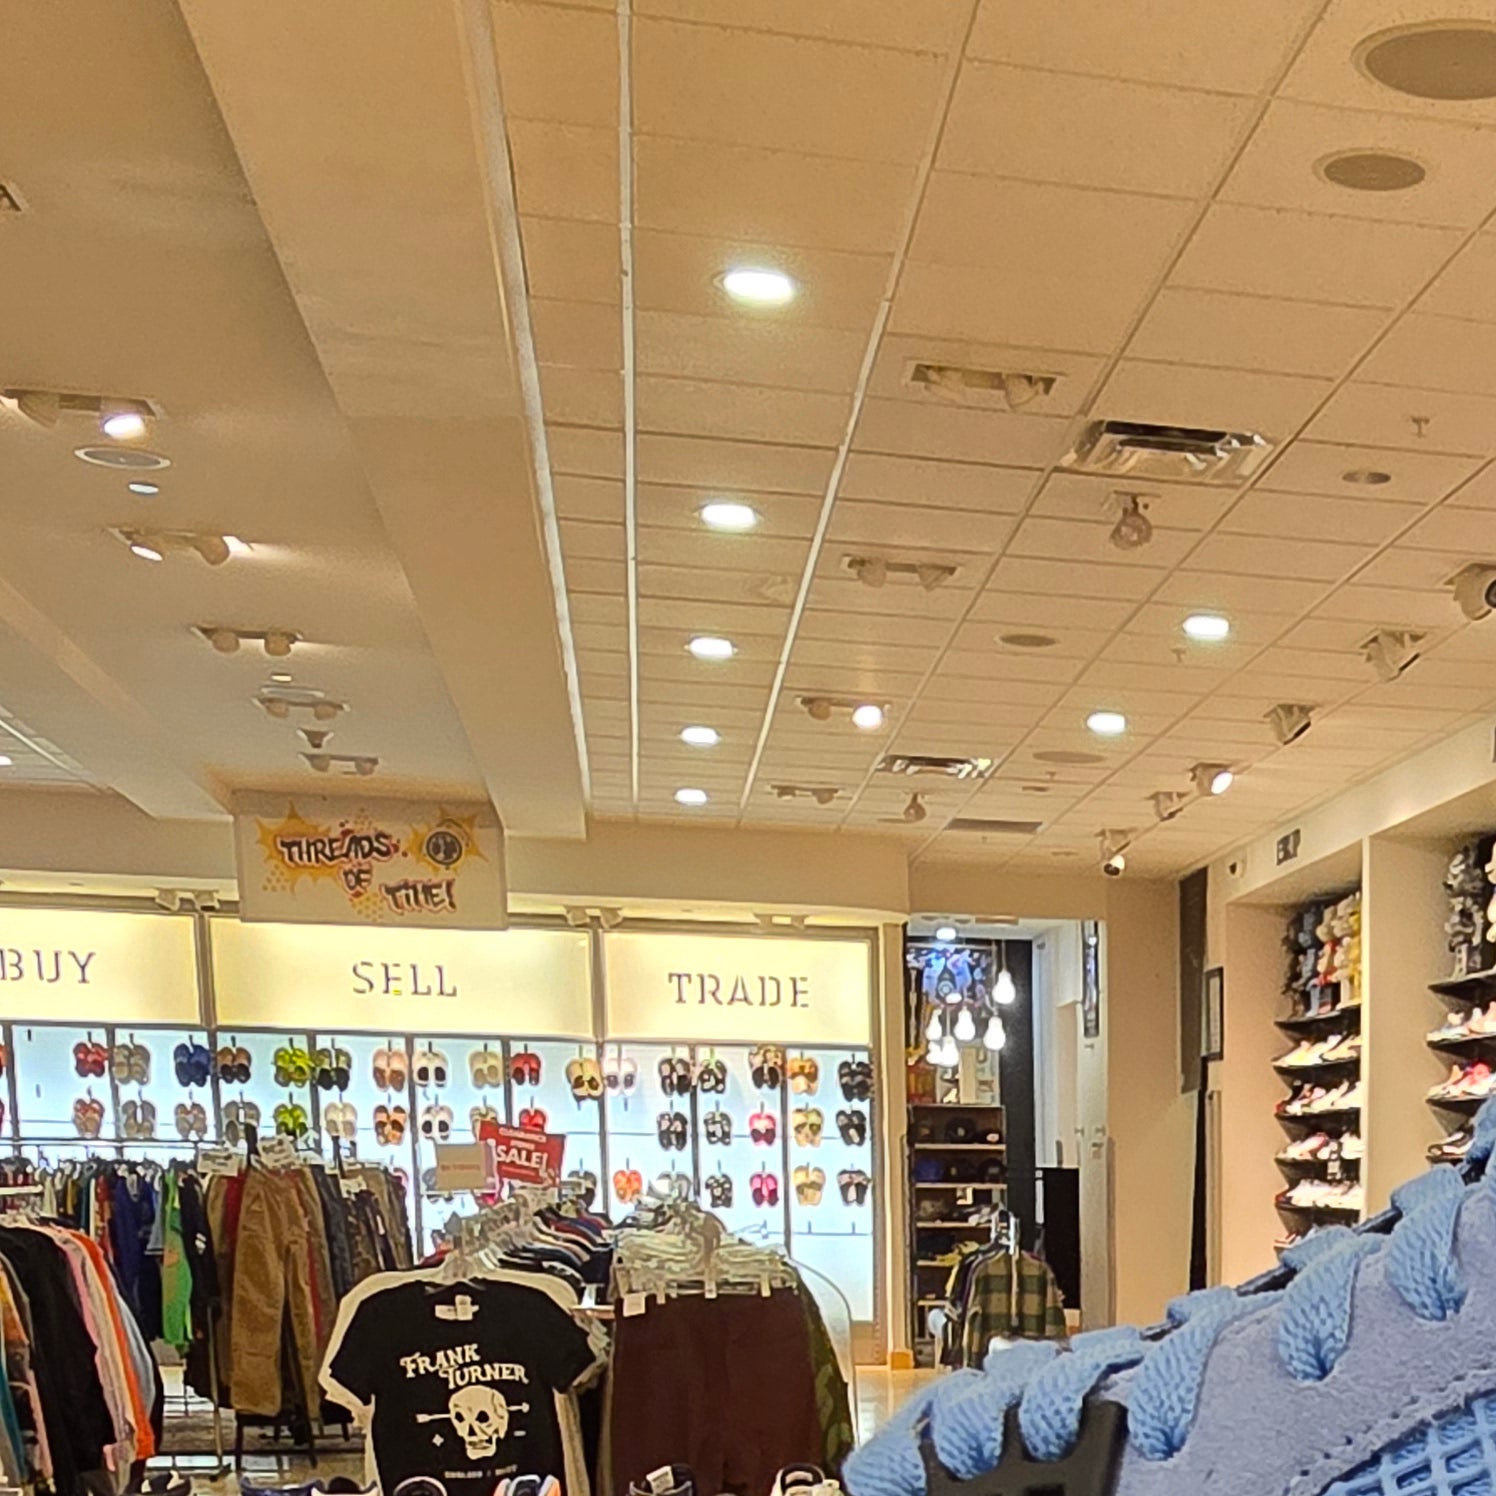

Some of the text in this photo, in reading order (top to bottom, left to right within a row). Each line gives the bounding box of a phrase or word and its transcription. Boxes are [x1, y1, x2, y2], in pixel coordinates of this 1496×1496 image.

[279, 830, 392, 865] THREADS
[0, 948, 96, 984] BUY
[352, 961, 457, 998] SELL
[668, 972, 809, 1008] TRADE
[400, 1343, 480, 1379] FRANK
[438, 1362, 529, 1390] TURNER
